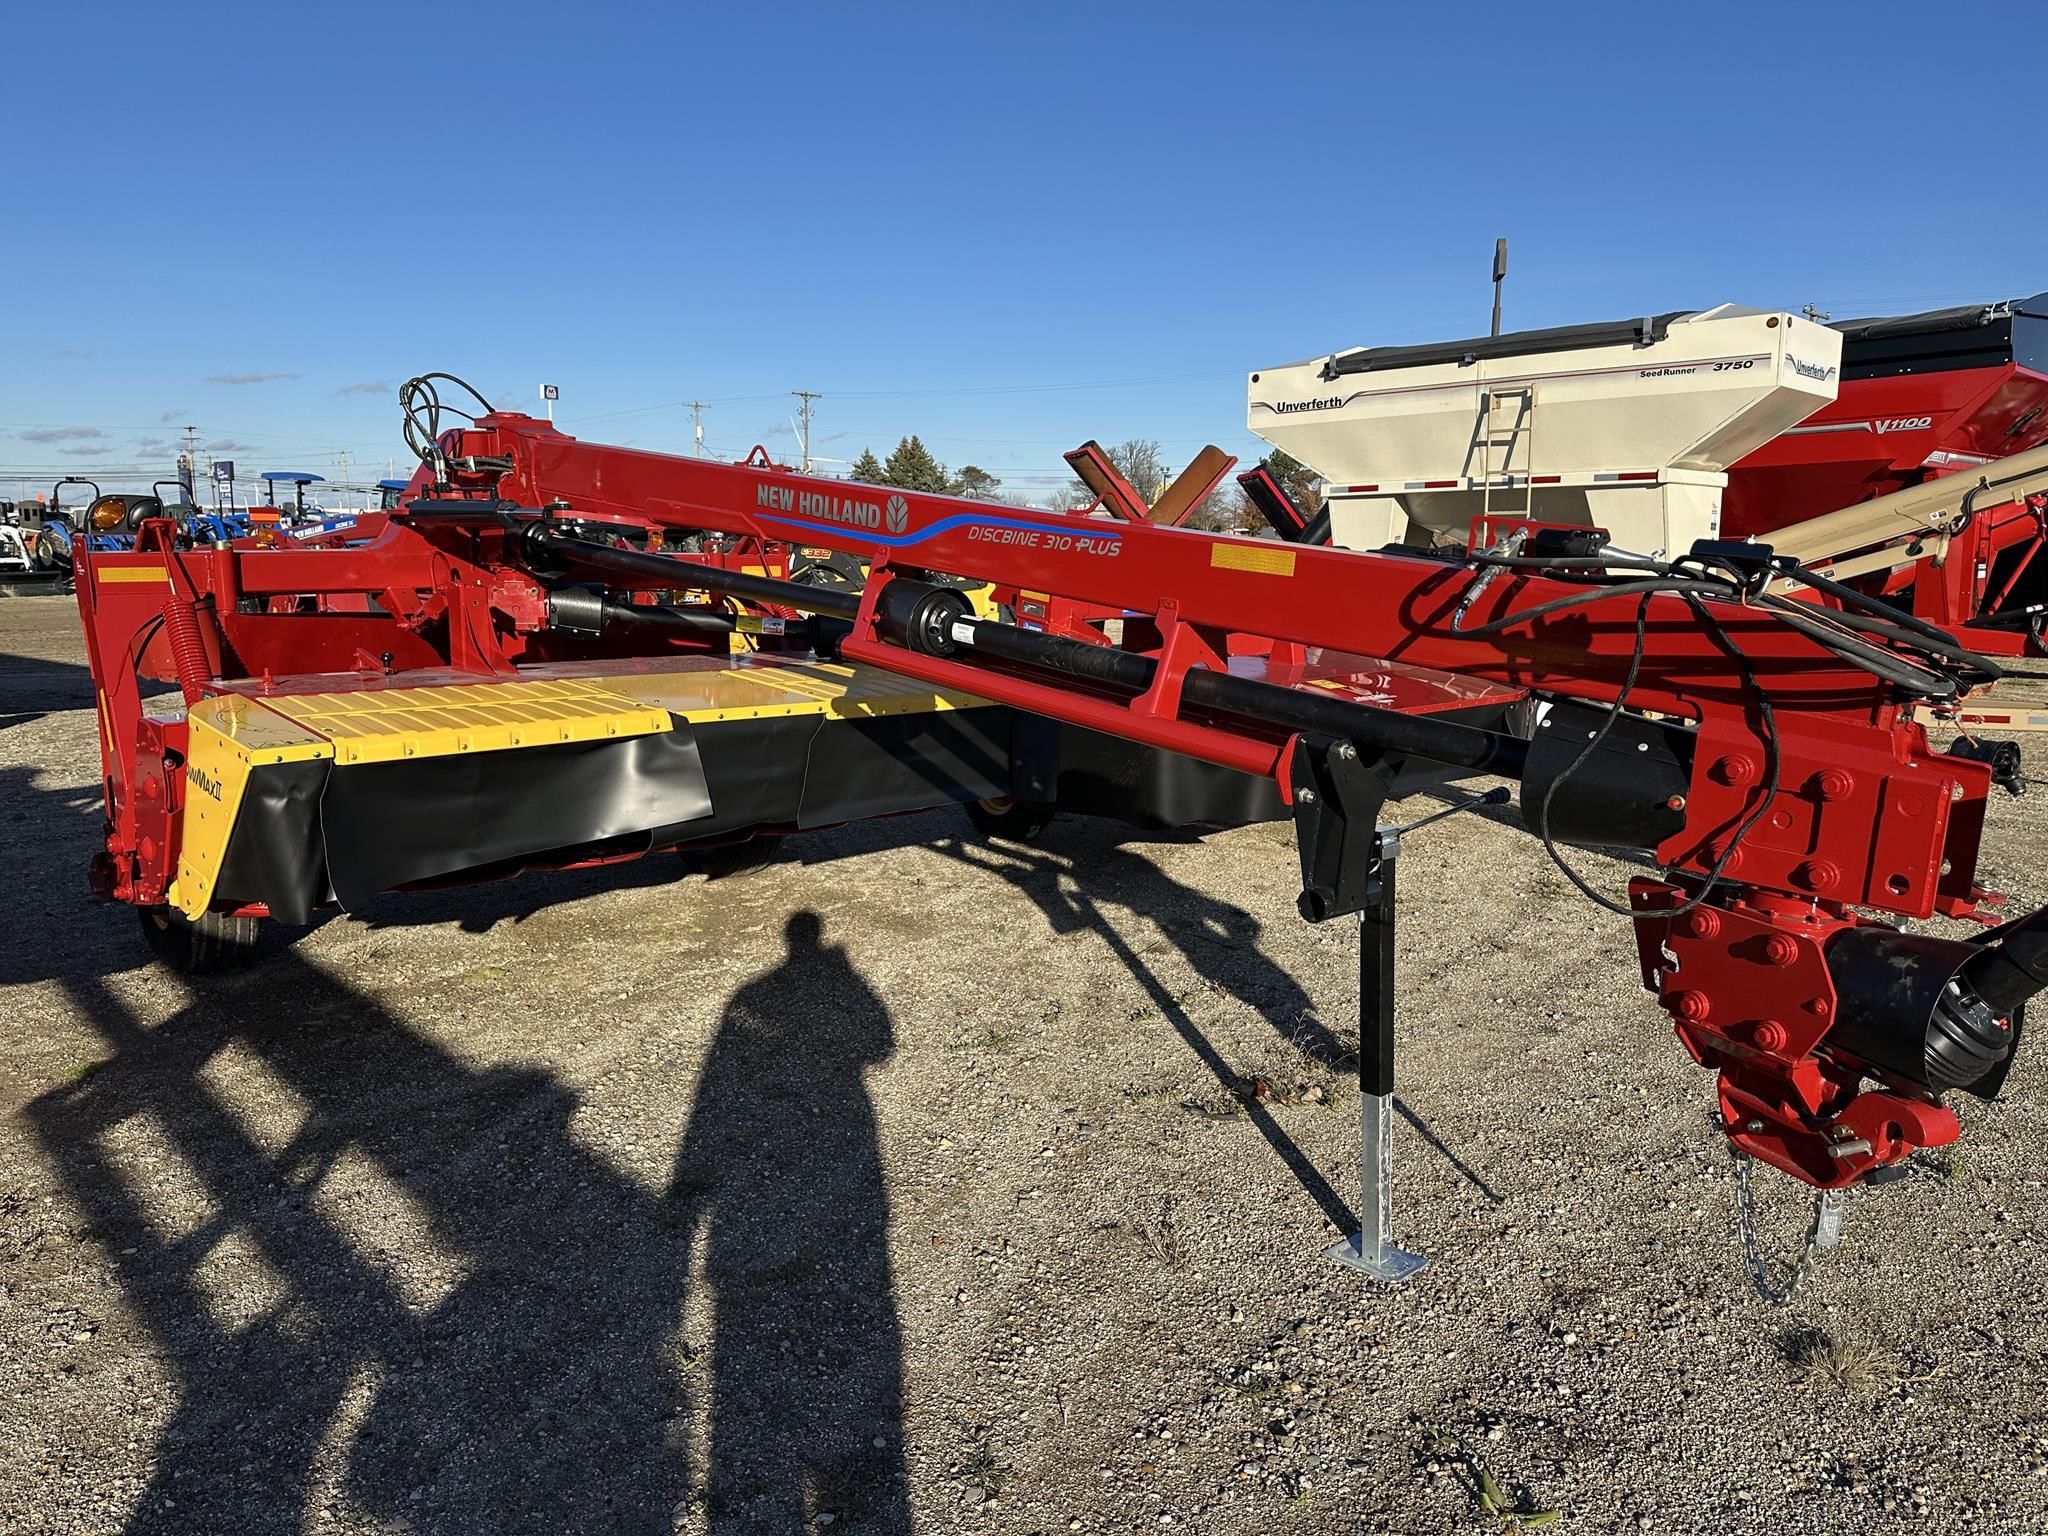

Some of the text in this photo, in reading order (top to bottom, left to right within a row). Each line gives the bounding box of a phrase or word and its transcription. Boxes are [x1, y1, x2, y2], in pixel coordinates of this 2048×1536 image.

[1712, 360, 1754, 371] 3750
[1276, 396, 1343, 413] Unverferth
[1875, 416, 1932, 434] V1100
[756, 483, 881, 530] NEW HOLLAND
[967, 525, 1041, 548] DISCBINE
[1042, 534, 1073, 552] 310
